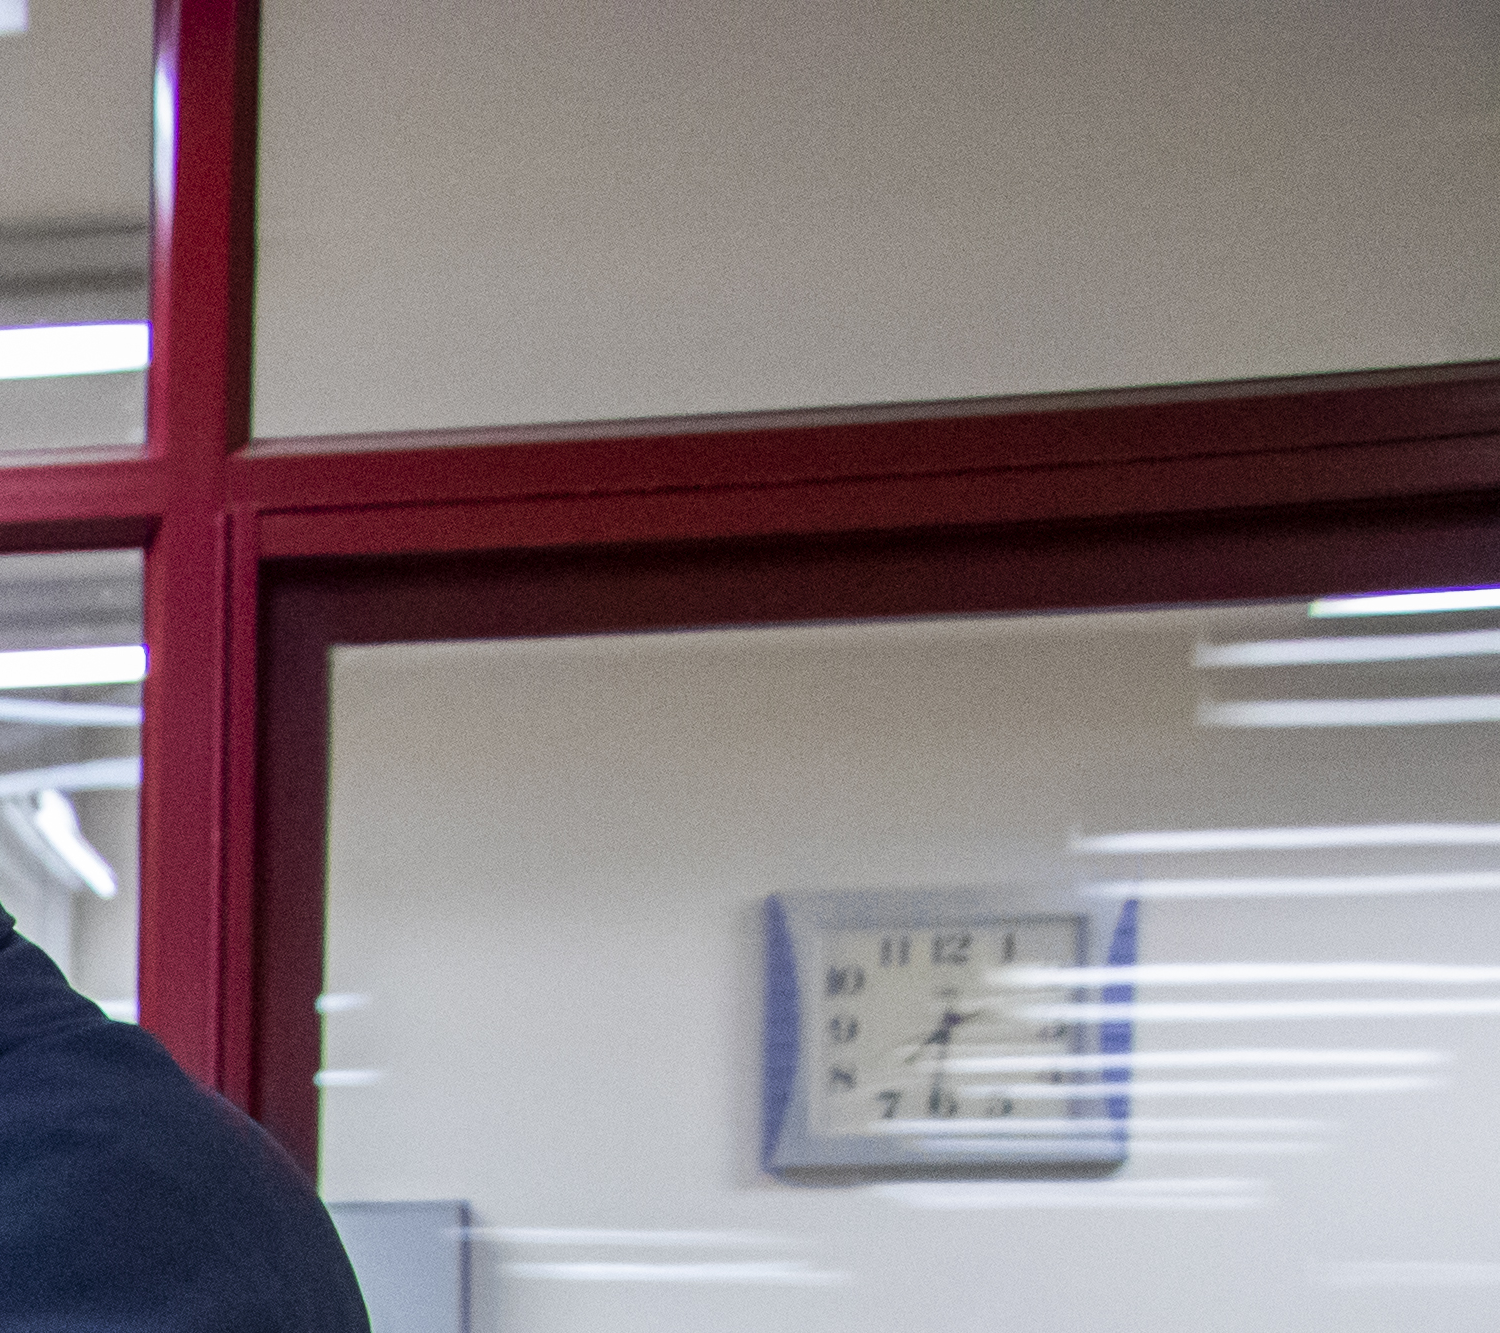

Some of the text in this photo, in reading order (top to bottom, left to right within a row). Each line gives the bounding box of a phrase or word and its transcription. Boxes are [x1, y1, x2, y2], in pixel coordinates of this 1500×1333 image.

[879, 933, 1016, 967] 11 12 1
[876, 1089, 902, 1119] 7
